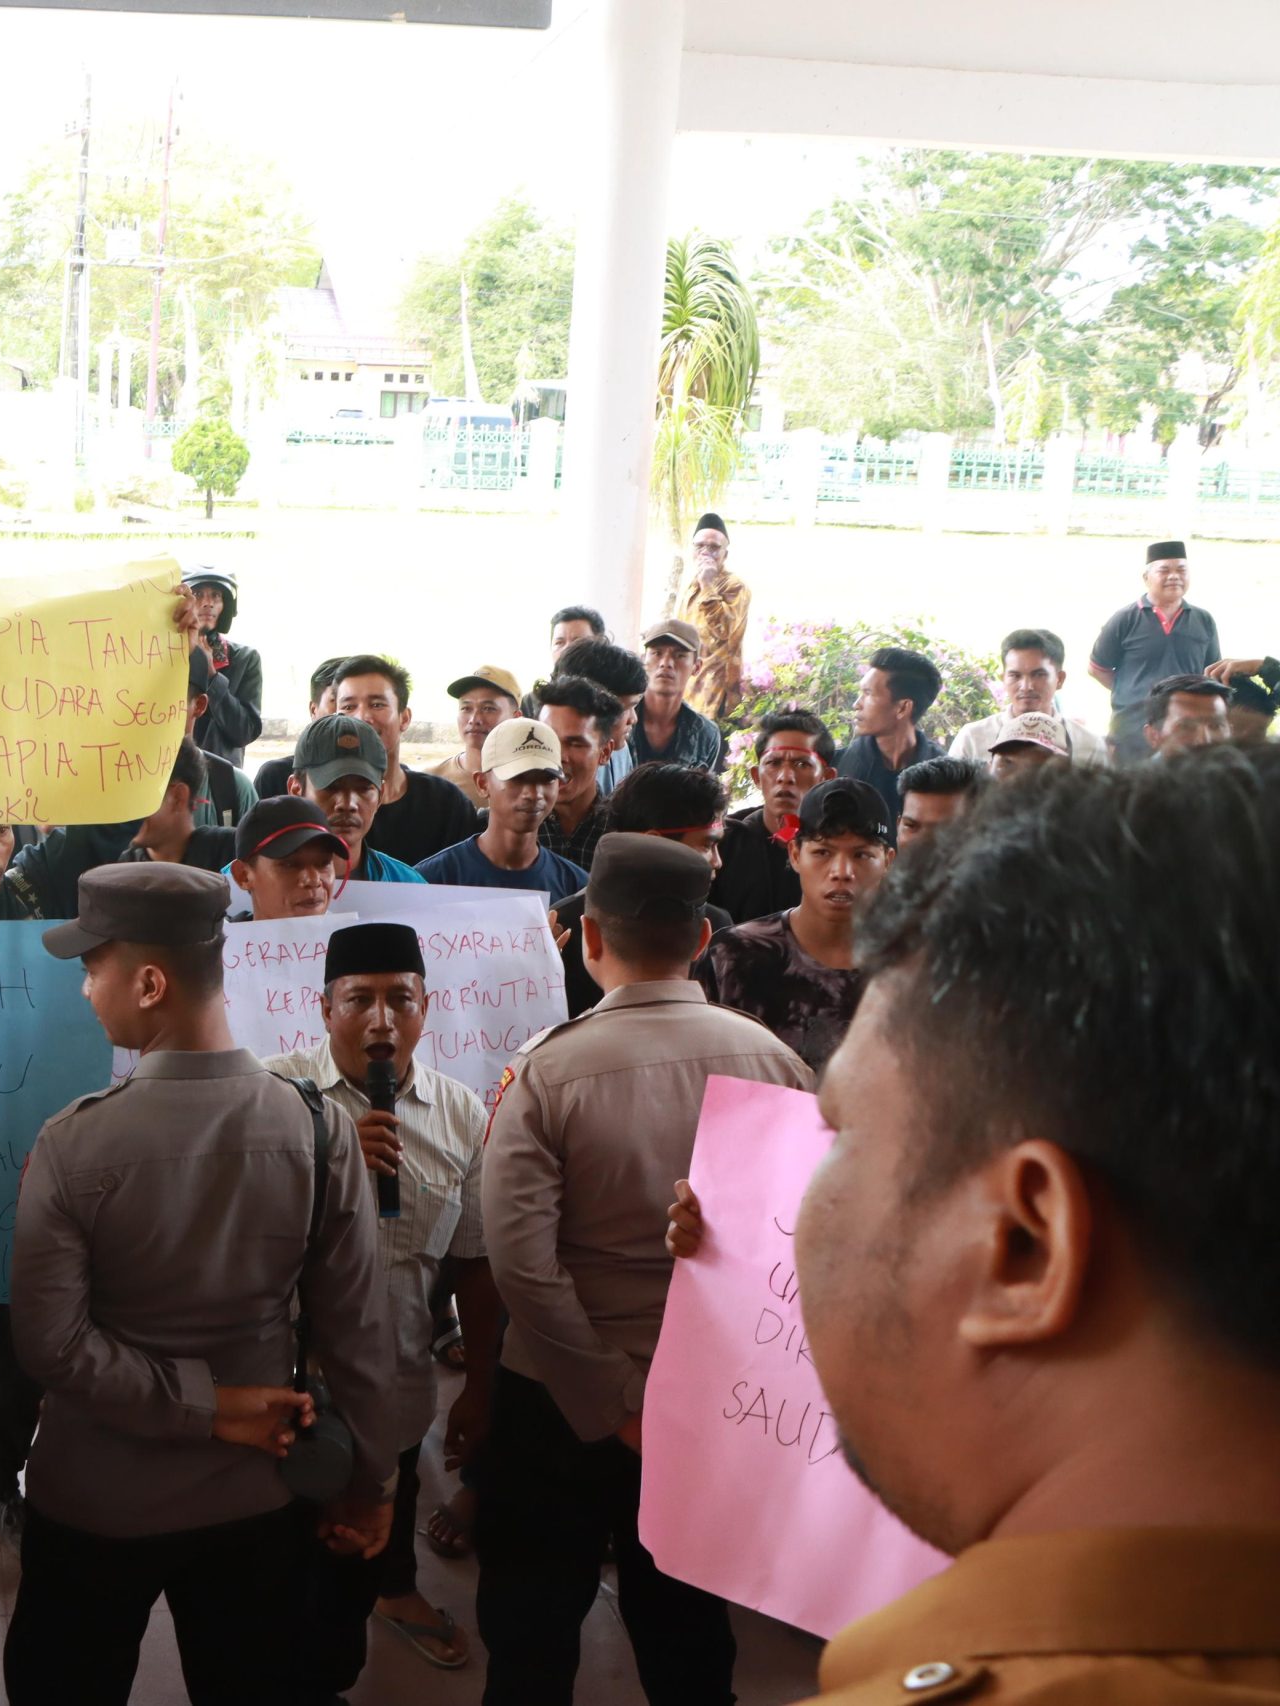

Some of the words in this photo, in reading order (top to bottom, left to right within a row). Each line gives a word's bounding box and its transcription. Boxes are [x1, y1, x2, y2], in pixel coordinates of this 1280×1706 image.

[68, 617, 188, 671] TANAH
[1, 678, 103, 717] UDARA
[113, 689, 188, 727] SEGAR
[80, 741, 179, 793] TANA
[223, 937, 328, 969] GERAKA
[418, 926, 550, 961] ASYARAKAT
[266, 985, 321, 1016] KEPA
[722, 1380, 842, 1465] SAUD
